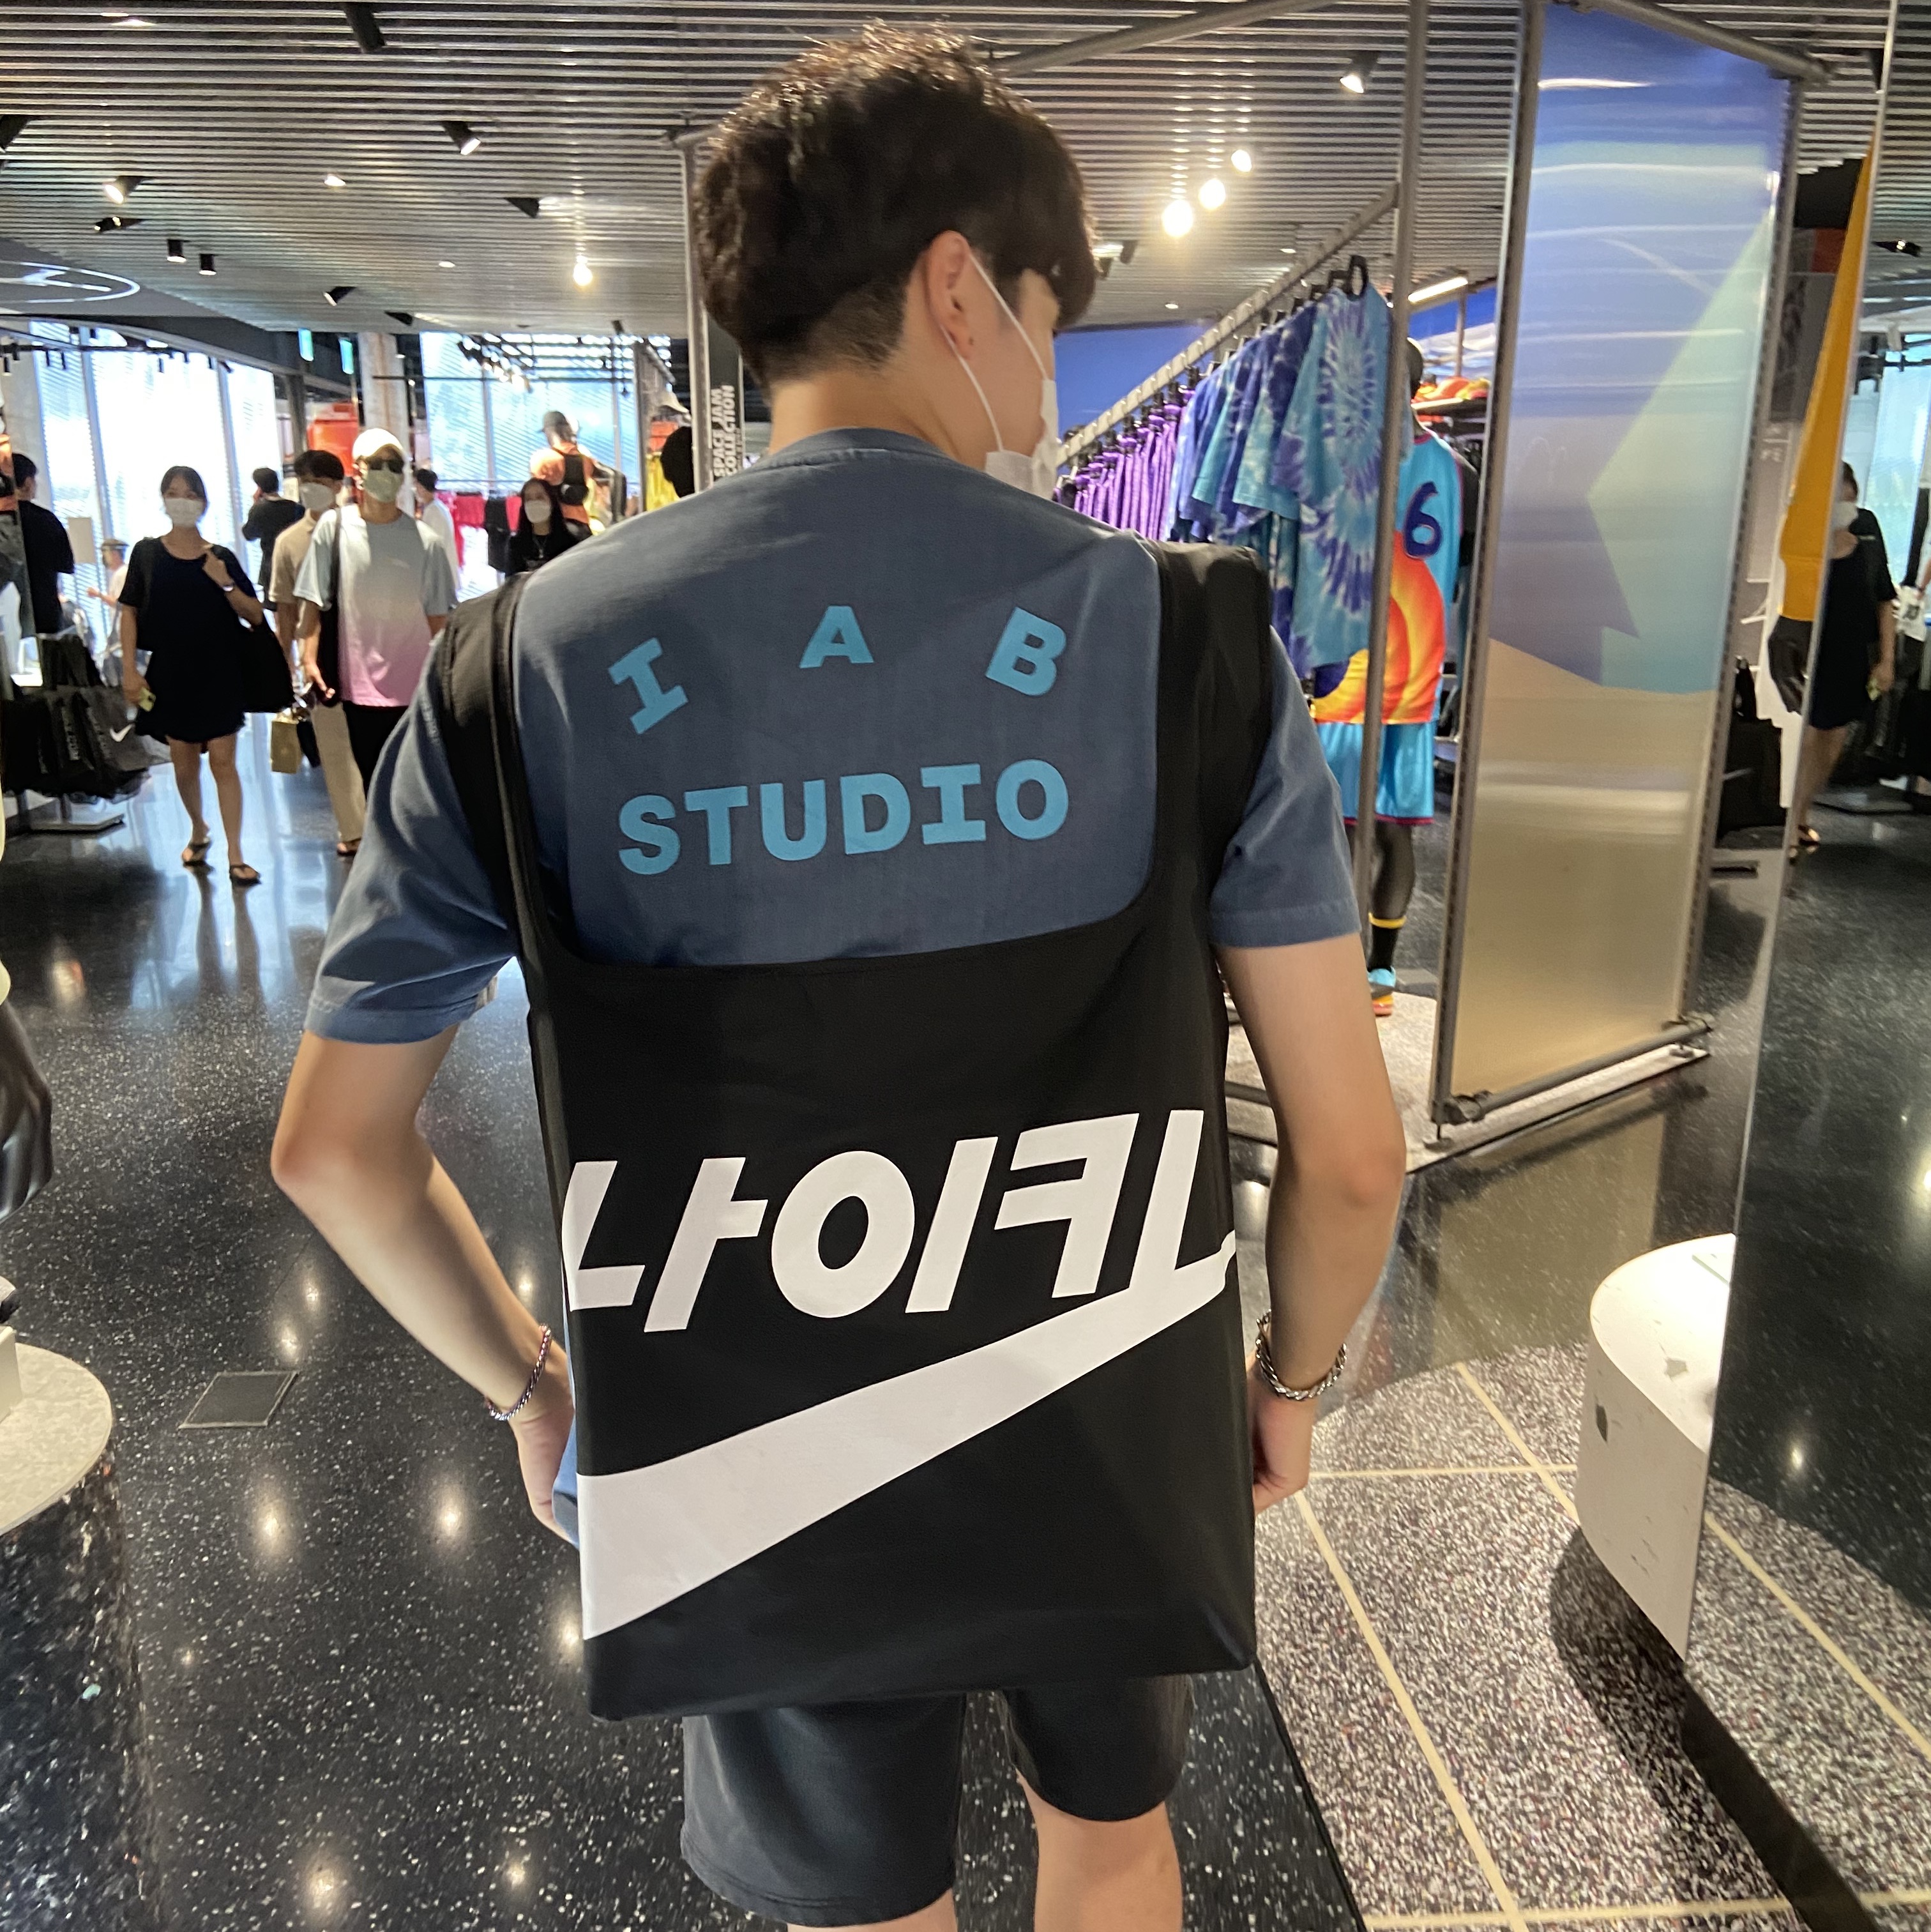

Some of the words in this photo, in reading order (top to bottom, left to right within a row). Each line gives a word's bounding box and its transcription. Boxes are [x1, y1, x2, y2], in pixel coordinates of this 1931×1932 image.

[711, 388, 723, 424] JAM
[721, 384, 736, 476] COLLECTION
[712, 430, 724, 477] SPACE
[1404, 481, 1443, 558] 6
[618, 759, 1069, 875] STUDIO
[562, 1110, 1204, 1332] 나이키
